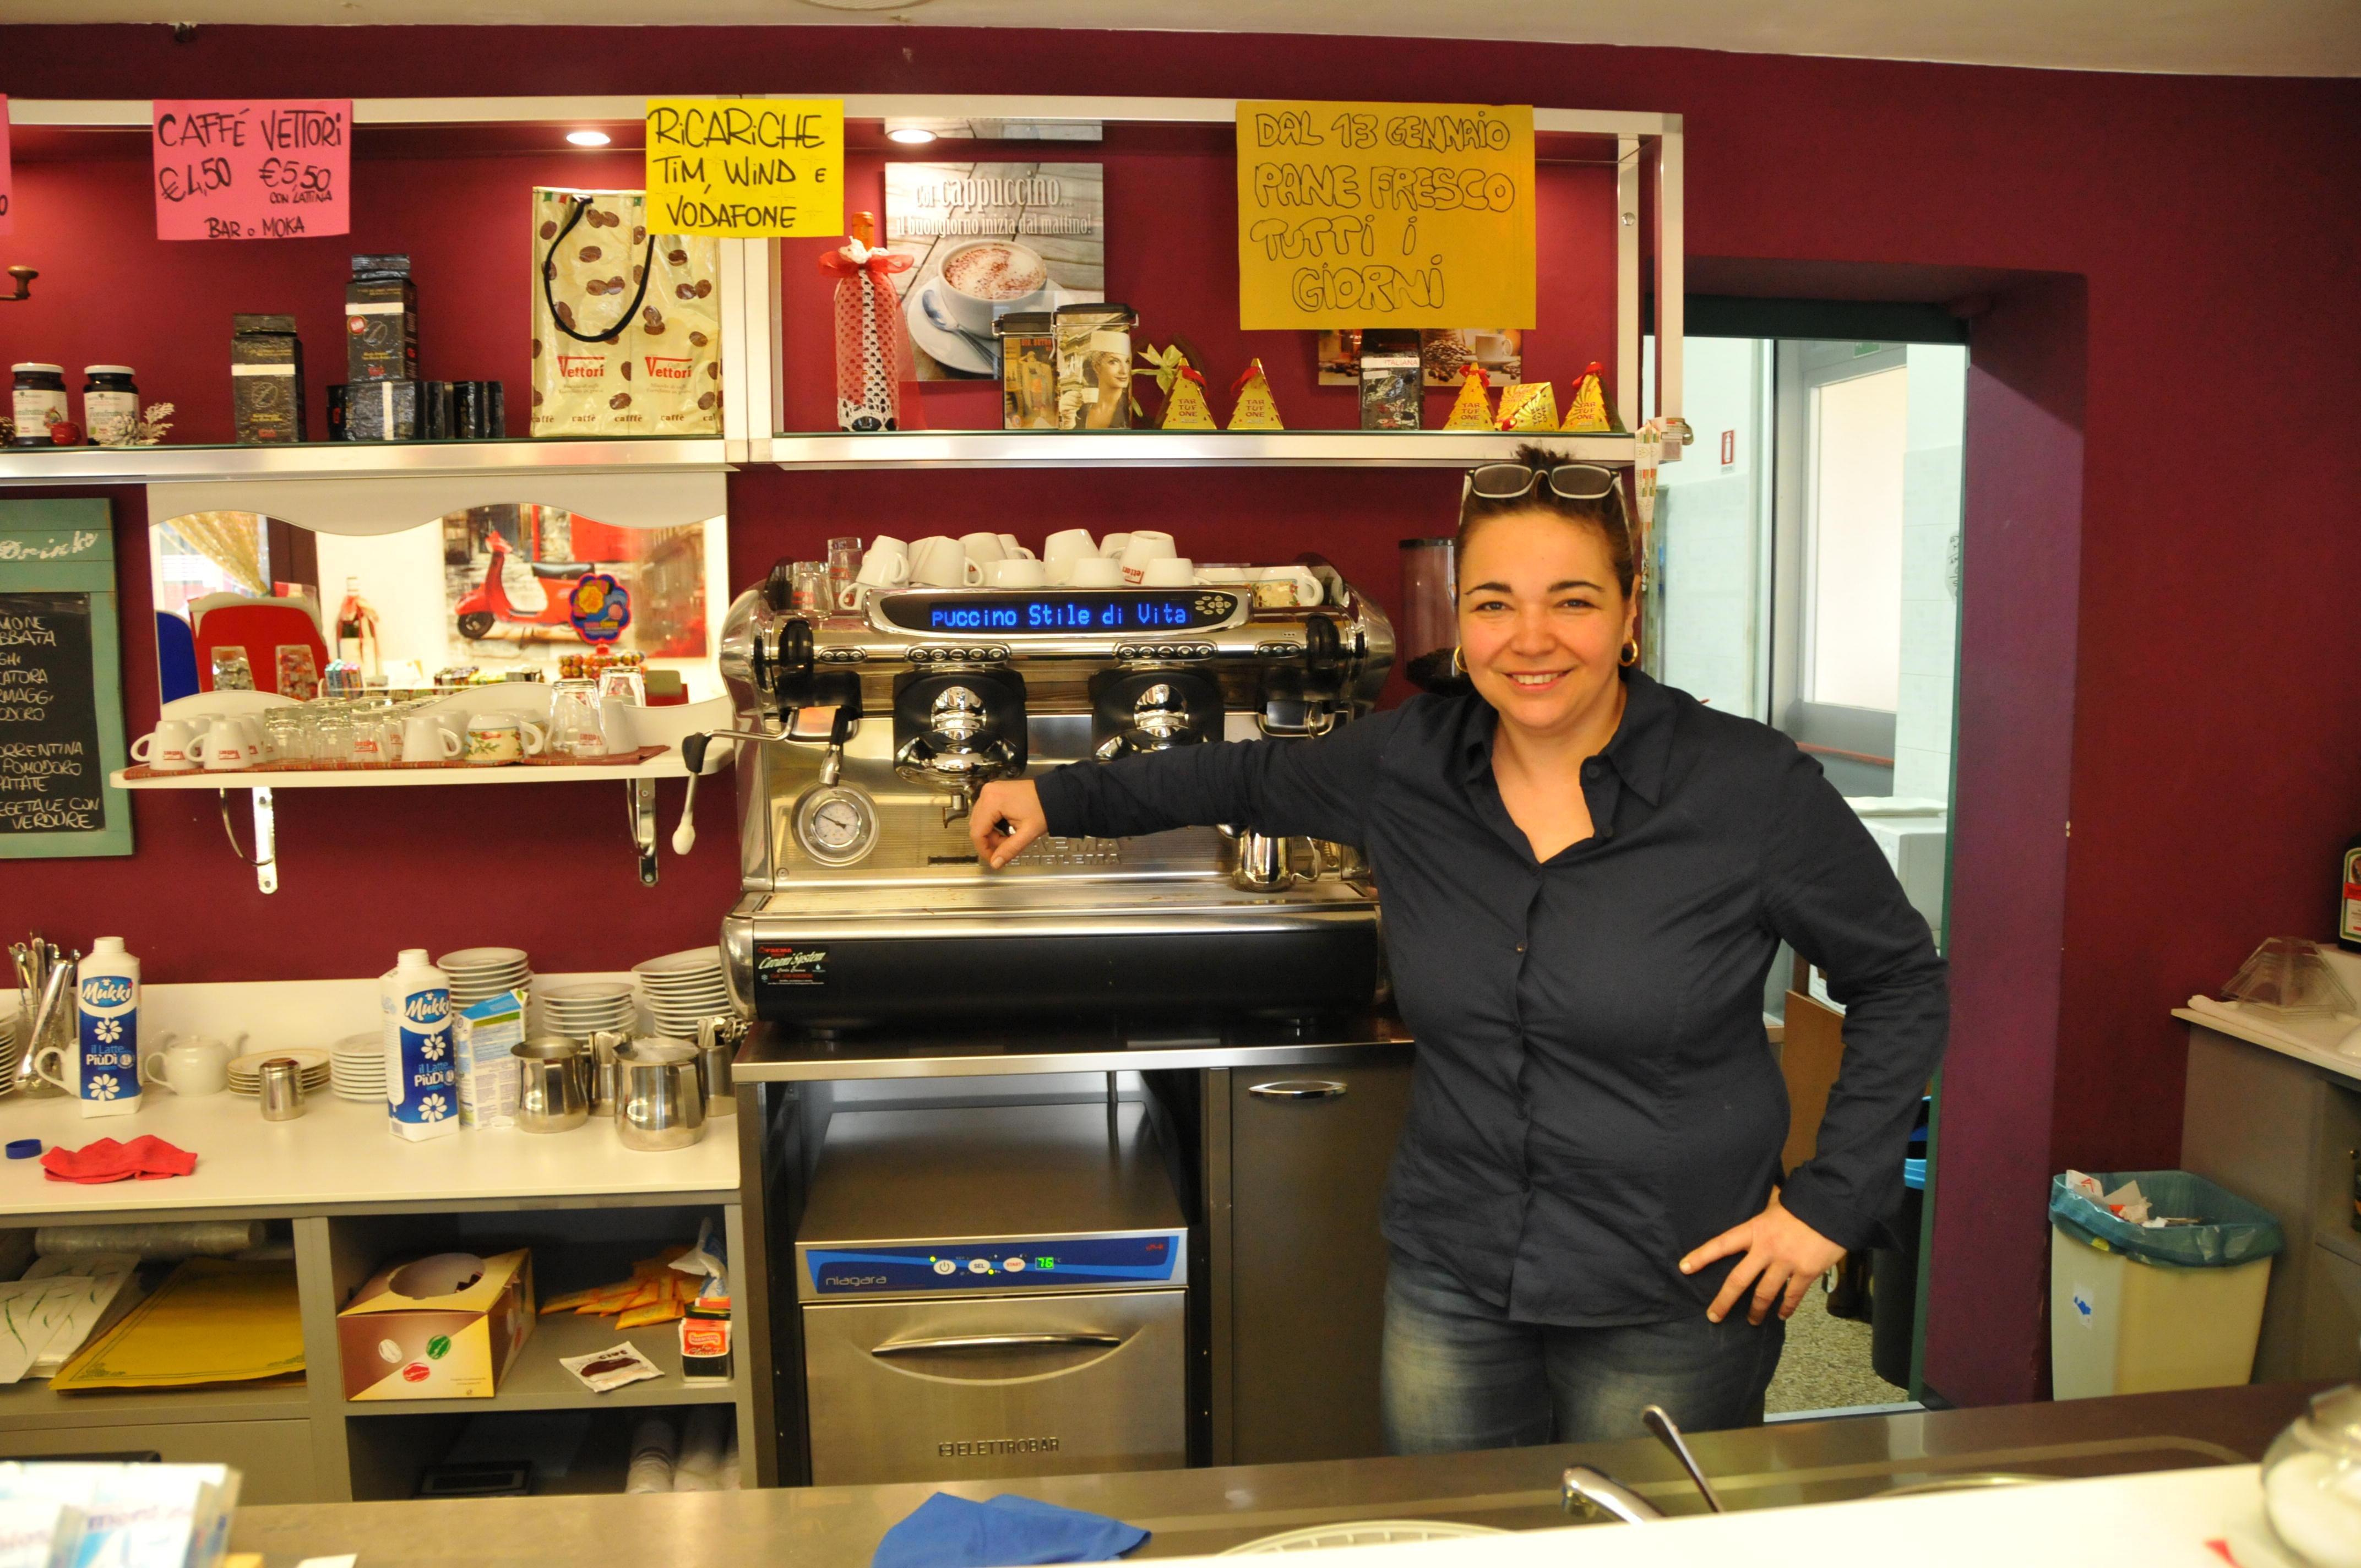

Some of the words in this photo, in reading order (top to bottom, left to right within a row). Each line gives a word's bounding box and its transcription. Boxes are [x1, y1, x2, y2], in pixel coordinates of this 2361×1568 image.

[1256, 111, 1324, 148] DAL
[1331, 112, 1378, 150] 13
[258, 157, 331, 192] €5,50
[1254, 162, 1361, 209] PANE
[1370, 166, 1515, 213] FRESCO
[666, 195, 797, 228] VODAFONE
[204, 217, 241, 238] BAR
[262, 216, 304, 237] MOKA
[909, 216, 979, 238] buongiorno
[981, 215, 1016, 236] inizia
[1019, 215, 1038, 235] dal
[1041, 214, 1092, 235] mattino!
[1029, 605, 1090, 625] Stile
[1102, 604, 1122, 624] di
[1138, 603, 1186, 624] Vita
[3, 758, 81, 776] POMODORO
[69, 797, 99, 810] CON
[12, 811, 95, 829] VERDURE
[83, 981, 133, 1004] Mukki
[99, 1044, 124, 1054] Latte
[1038, 1257, 1053, 1268] 76
[826, 1275, 887, 1287] niagara
[956, 1436, 1059, 1456] ELETTROBAR
